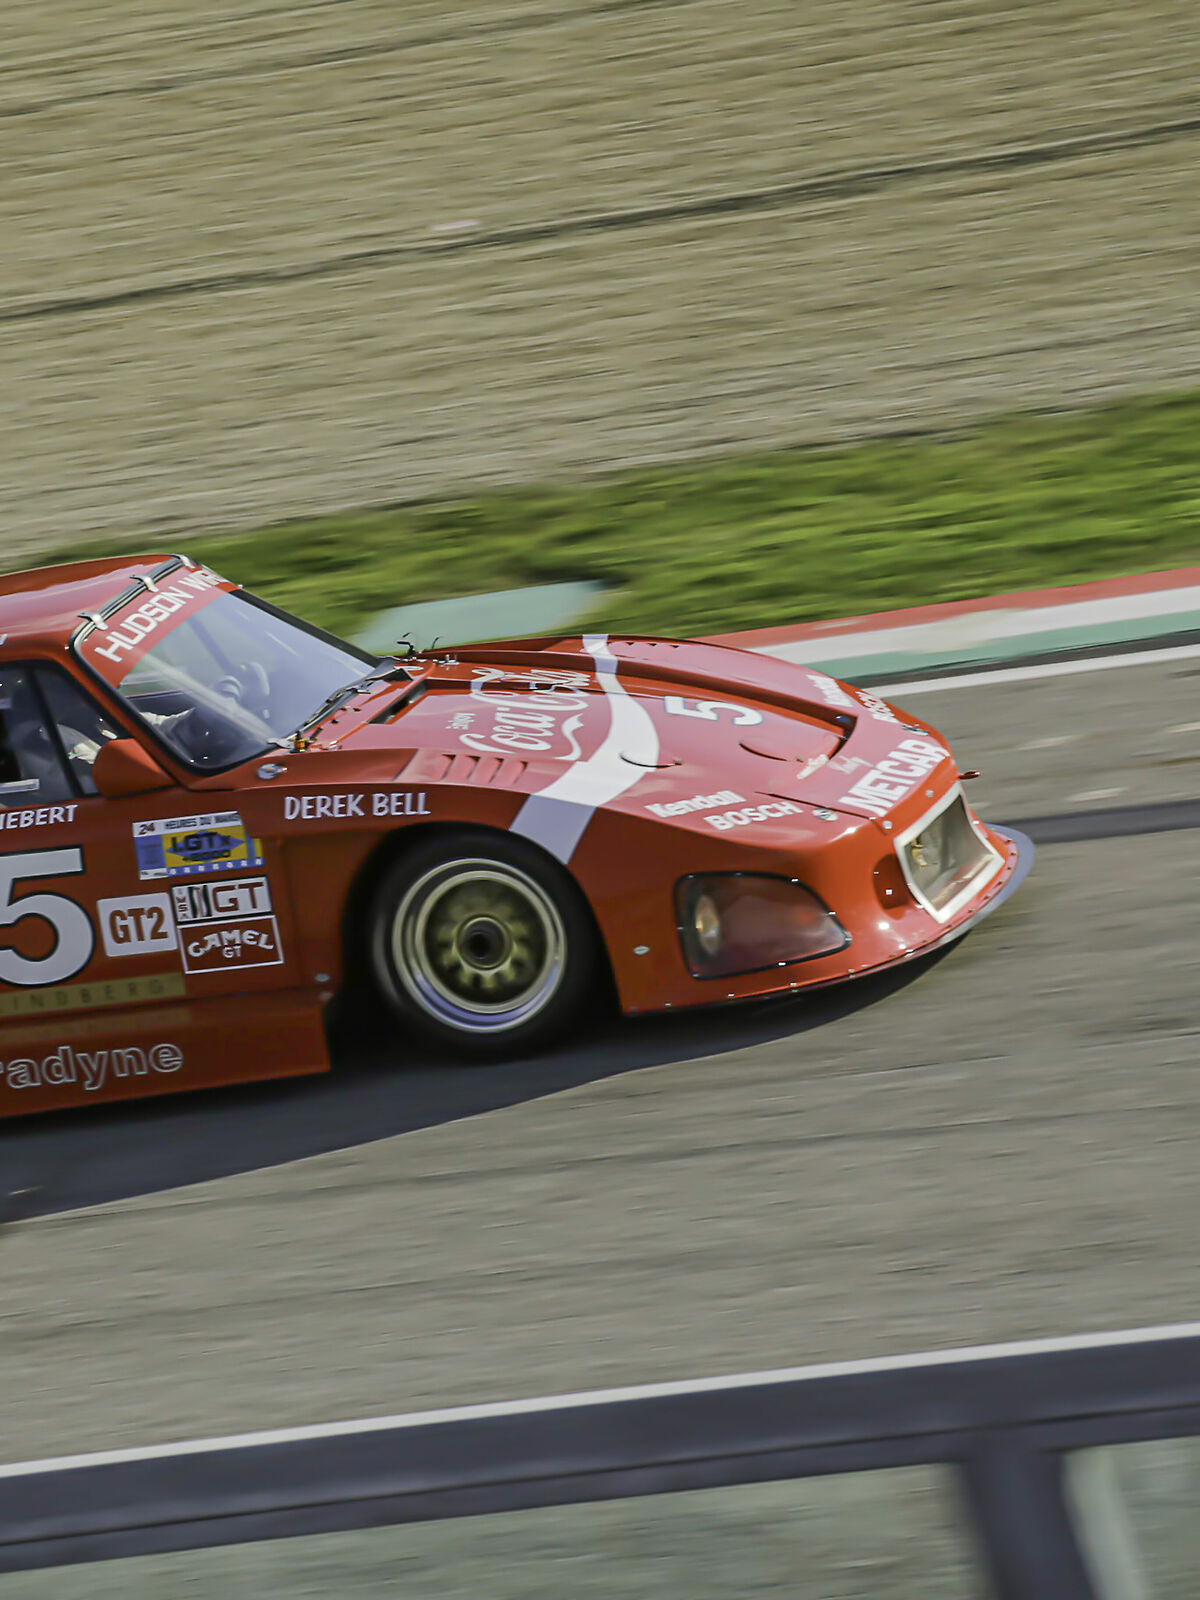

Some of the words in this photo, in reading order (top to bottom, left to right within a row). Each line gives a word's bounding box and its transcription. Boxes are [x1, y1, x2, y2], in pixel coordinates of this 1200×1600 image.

[94, 586, 195, 663] HUDSON
[459, 666, 592, 761] Coca-Cola
[663, 695, 764, 726] 5
[838, 739, 950, 817] METCAR
[284, 794, 365, 820] DEREK
[372, 792, 431, 816] BELL
[644, 790, 747, 818] Kendall
[703, 801, 804, 831] BOSCH
[138, 822, 156, 835] 24
[212, 882, 265, 913] GT
[109, 906, 168, 944] GT2
[187, 929, 274, 957] CAMEL
[222, 946, 241, 959] GT
